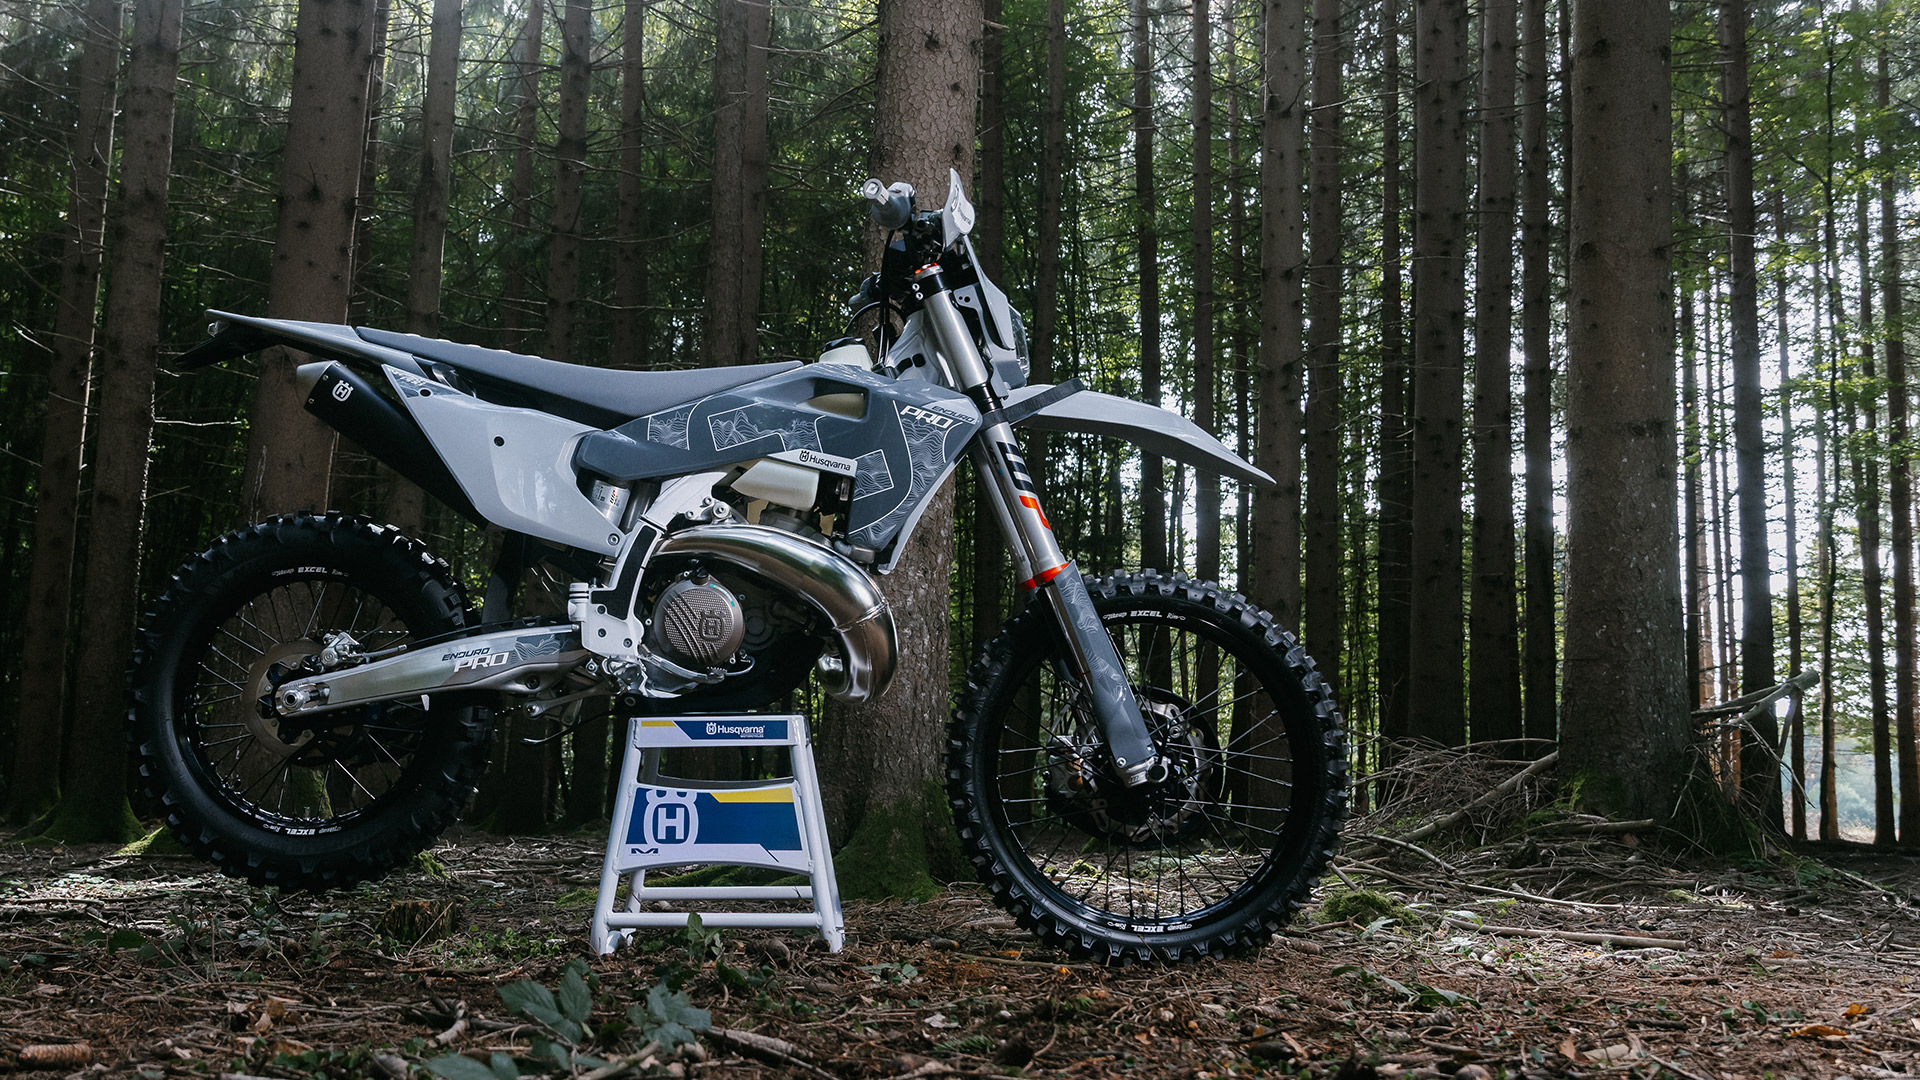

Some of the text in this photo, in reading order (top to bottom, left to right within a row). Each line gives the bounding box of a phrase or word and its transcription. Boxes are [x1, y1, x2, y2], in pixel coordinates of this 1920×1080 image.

[900, 405, 954, 429] PRO
[931, 405, 976, 423] ENDURO
[809, 454, 851, 471] Husqvarna
[297, 566, 328, 574] EXCEL
[1130, 610, 1162, 618] EXCEL
[441, 647, 491, 661] ENDURO
[453, 651, 510, 673] PRO
[717, 725, 764, 735] Husqvarna
[285, 827, 316, 836] EXCEL
[1131, 924, 1165, 933] EXCEL
